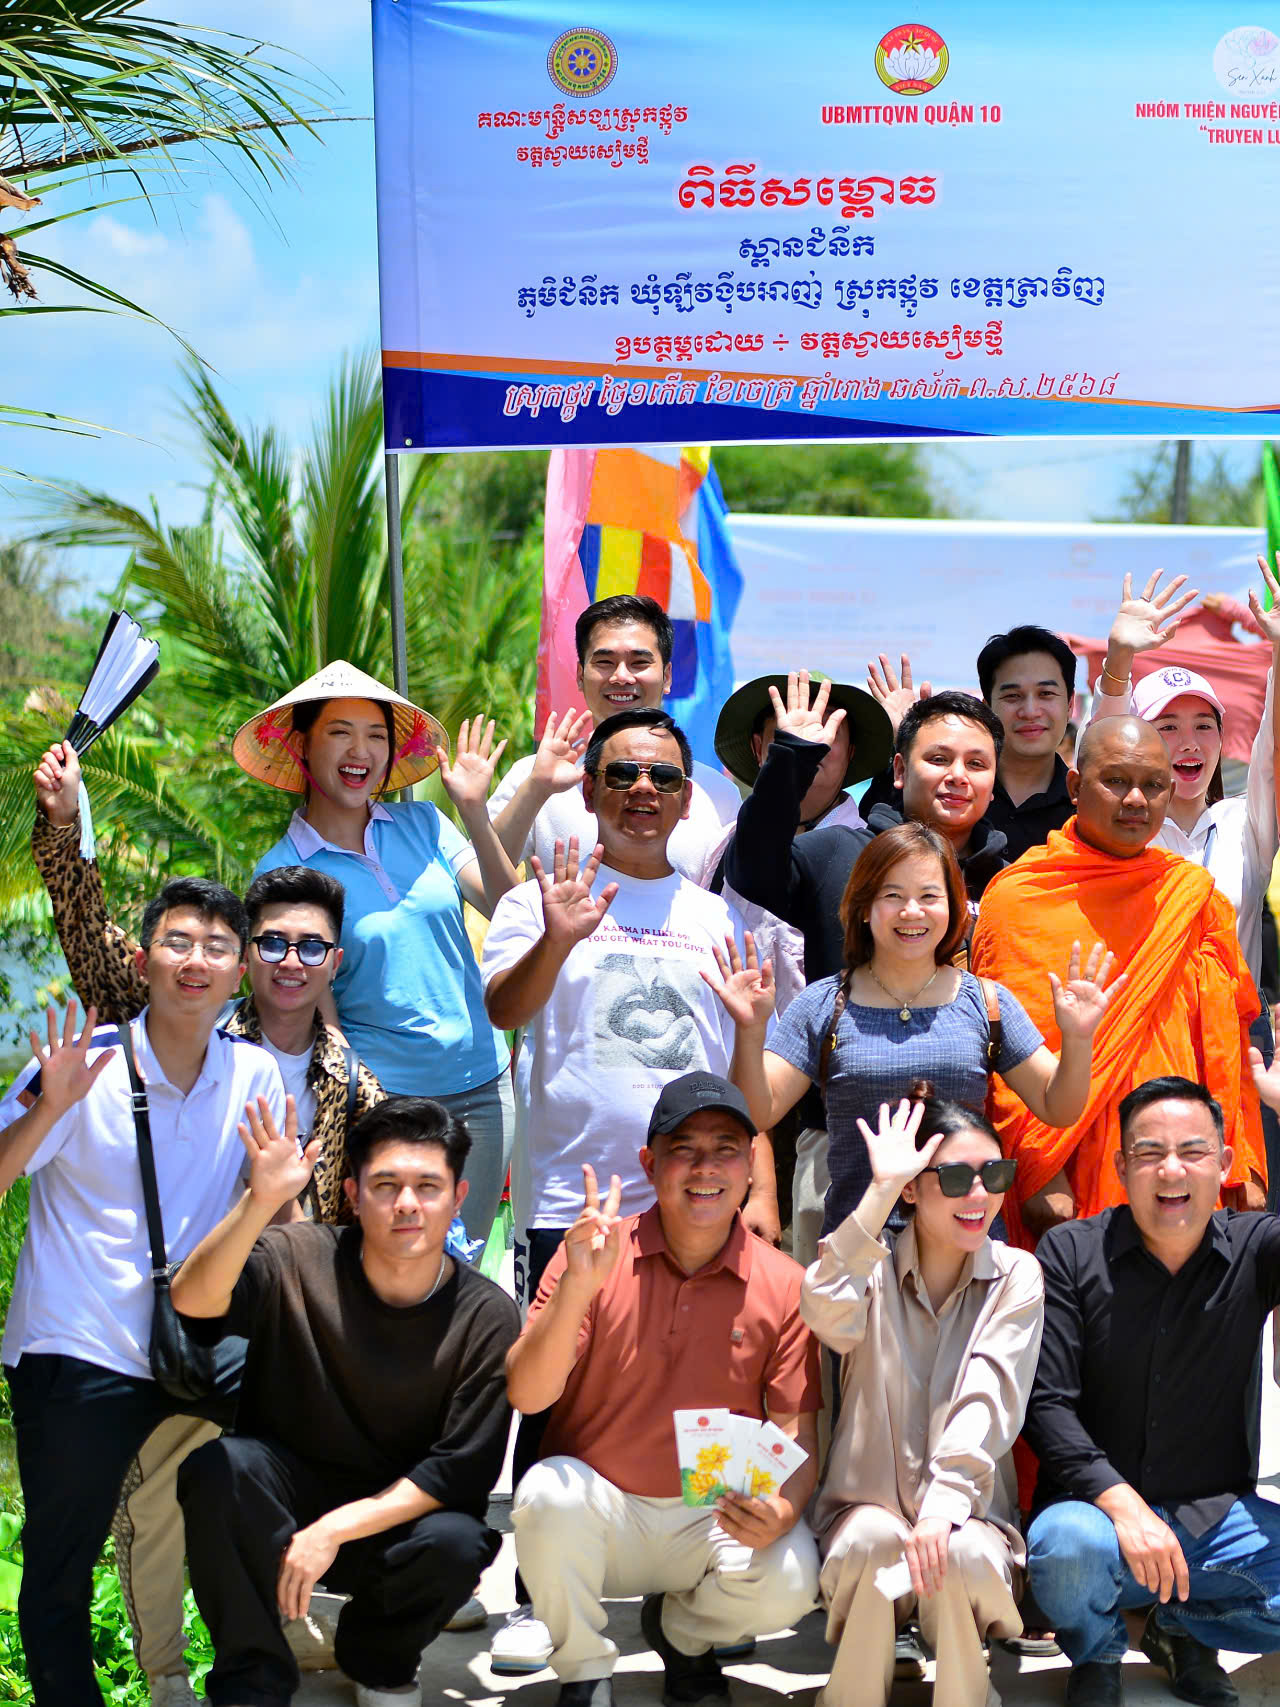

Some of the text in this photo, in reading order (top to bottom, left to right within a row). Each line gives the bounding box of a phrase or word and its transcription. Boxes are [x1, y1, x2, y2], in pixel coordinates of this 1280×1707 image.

[822, 101, 1001, 127] UBMTTQVN QUẬN 10
[1136, 101, 1179, 118] NHÓM
[1184, 101, 1225, 121] THIỆN
[603, 925, 638, 935] KARMA
[652, 929, 676, 937] LIKE
[631, 936, 659, 946] WHAT
[662, 940, 681, 948] YOU
